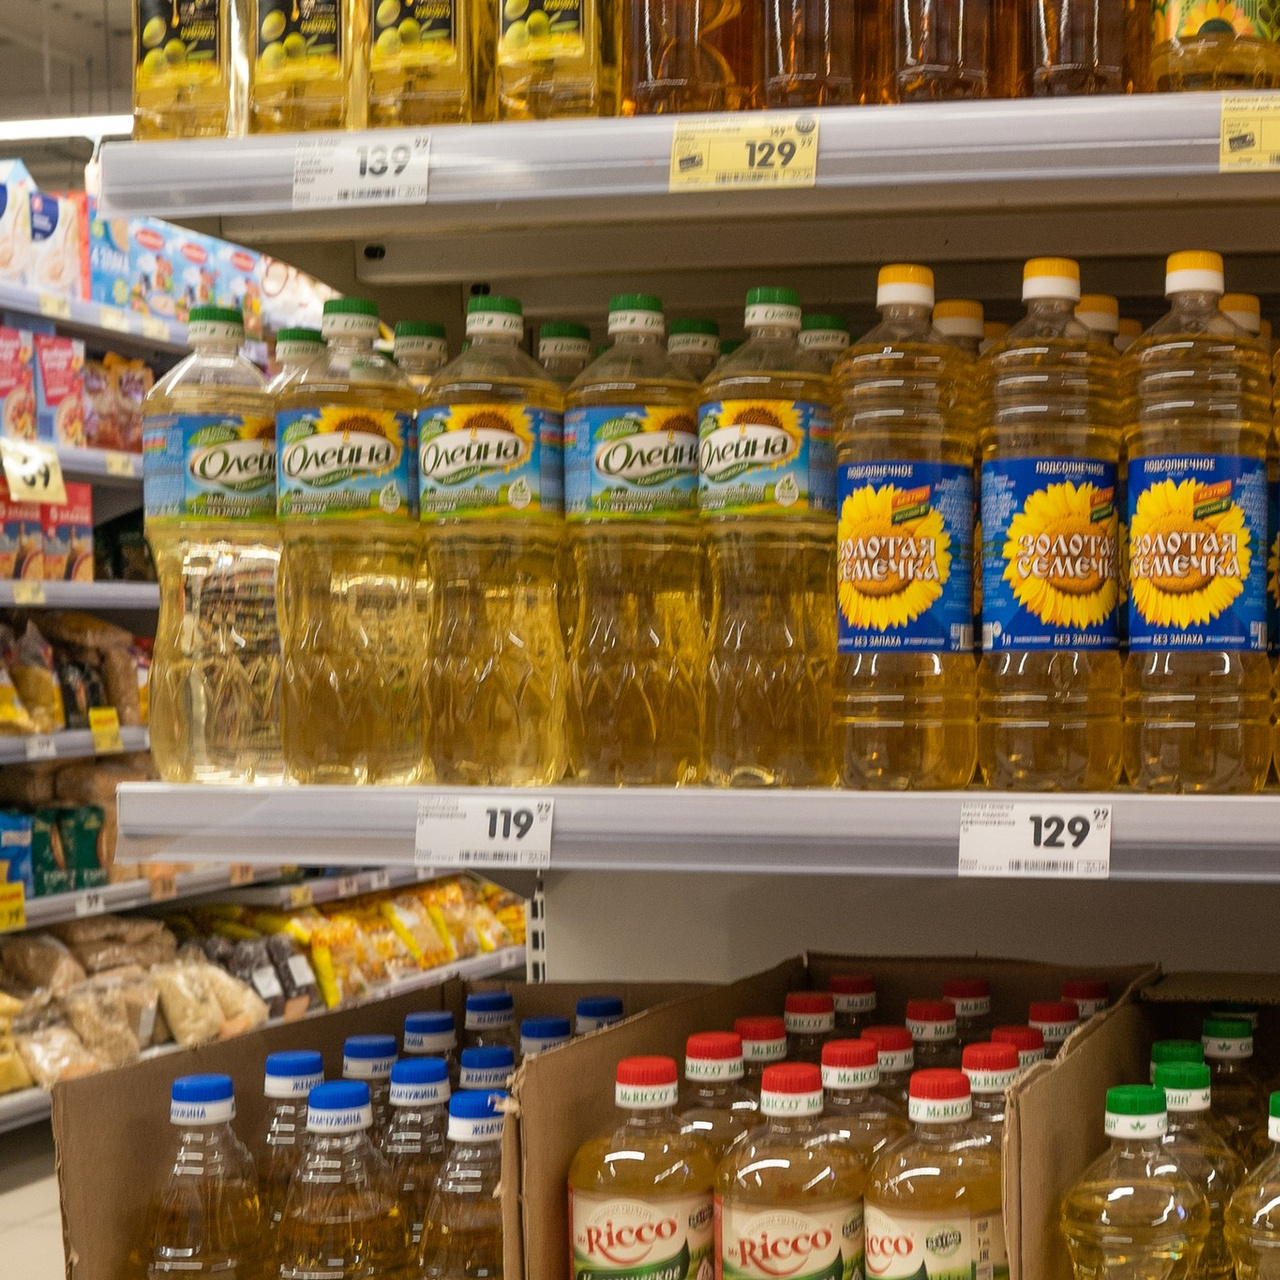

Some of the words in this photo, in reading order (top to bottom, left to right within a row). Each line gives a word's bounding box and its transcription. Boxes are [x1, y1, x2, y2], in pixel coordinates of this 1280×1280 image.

[355, 145, 412, 178] 139
[745, 140, 797, 169] 129
[199, 449, 277, 478] Олей
[284, 442, 392, 478] Олейна
[421, 436, 521, 477] Олейна
[486, 807, 534, 839] 119
[1029, 814, 1091, 848] 129
[1093, 808, 1109, 821] 99
[587, 1218, 678, 1254] Ricco
[739, 1227, 832, 1267] Ricco
